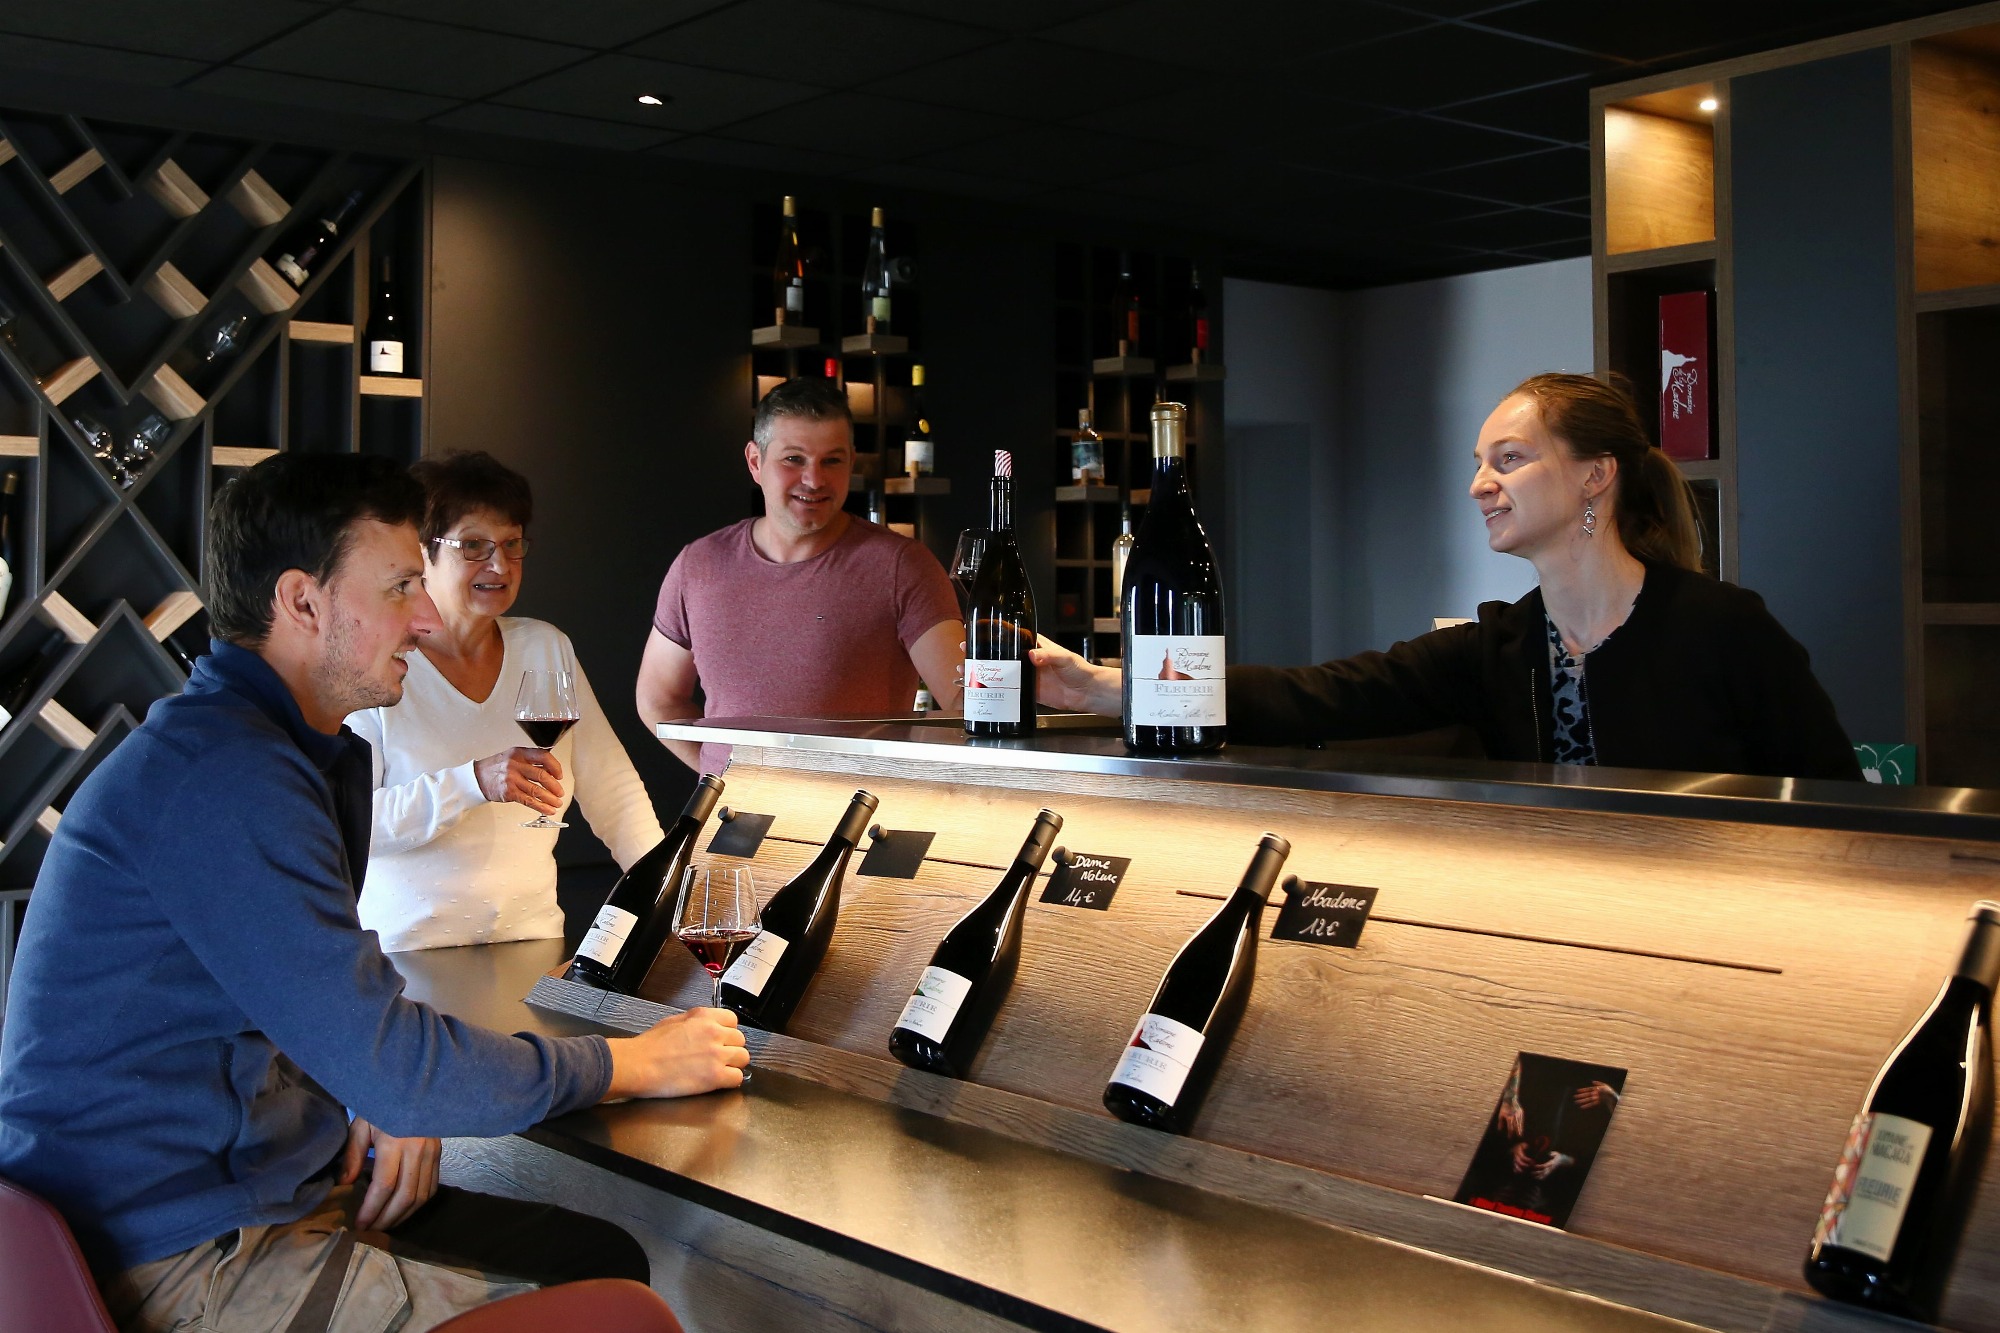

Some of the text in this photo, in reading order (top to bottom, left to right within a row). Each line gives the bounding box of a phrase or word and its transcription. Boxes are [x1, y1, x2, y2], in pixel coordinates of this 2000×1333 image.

[1687, 368, 1698, 415] Domaine
[1154, 683, 1214, 694] FLEURIE
[1069, 855, 1111, 870] Dame
